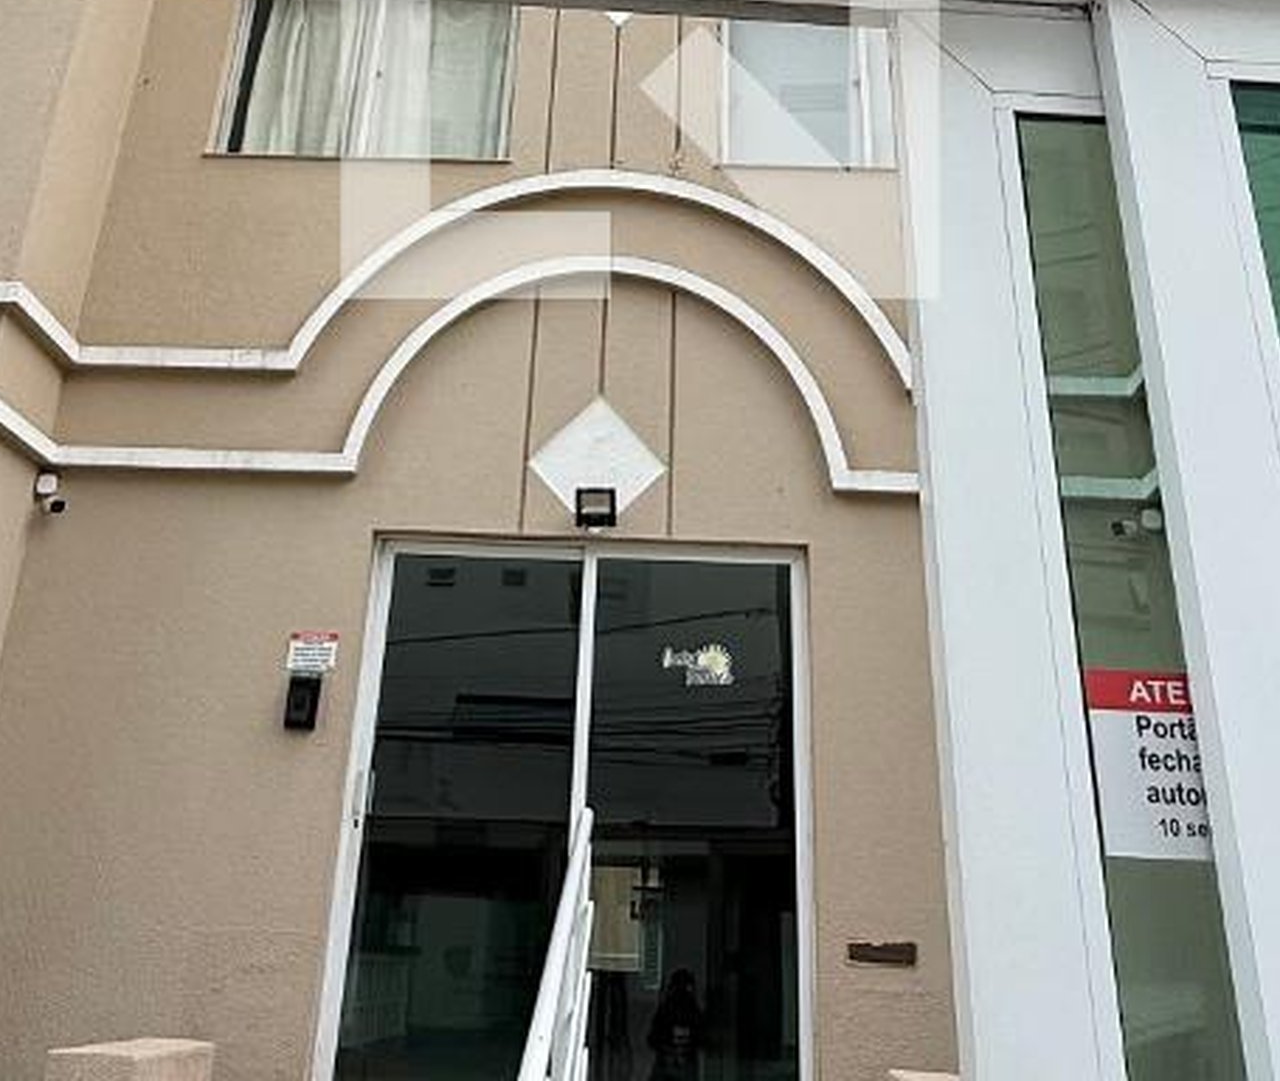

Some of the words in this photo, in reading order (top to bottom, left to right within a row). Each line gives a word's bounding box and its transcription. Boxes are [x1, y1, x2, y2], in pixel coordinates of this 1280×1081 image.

[1129, 680, 1188, 705] ATE
[1138, 746, 1202, 773] fecha
[1158, 818, 1181, 838] 10
[1186, 822, 1210, 838] se
